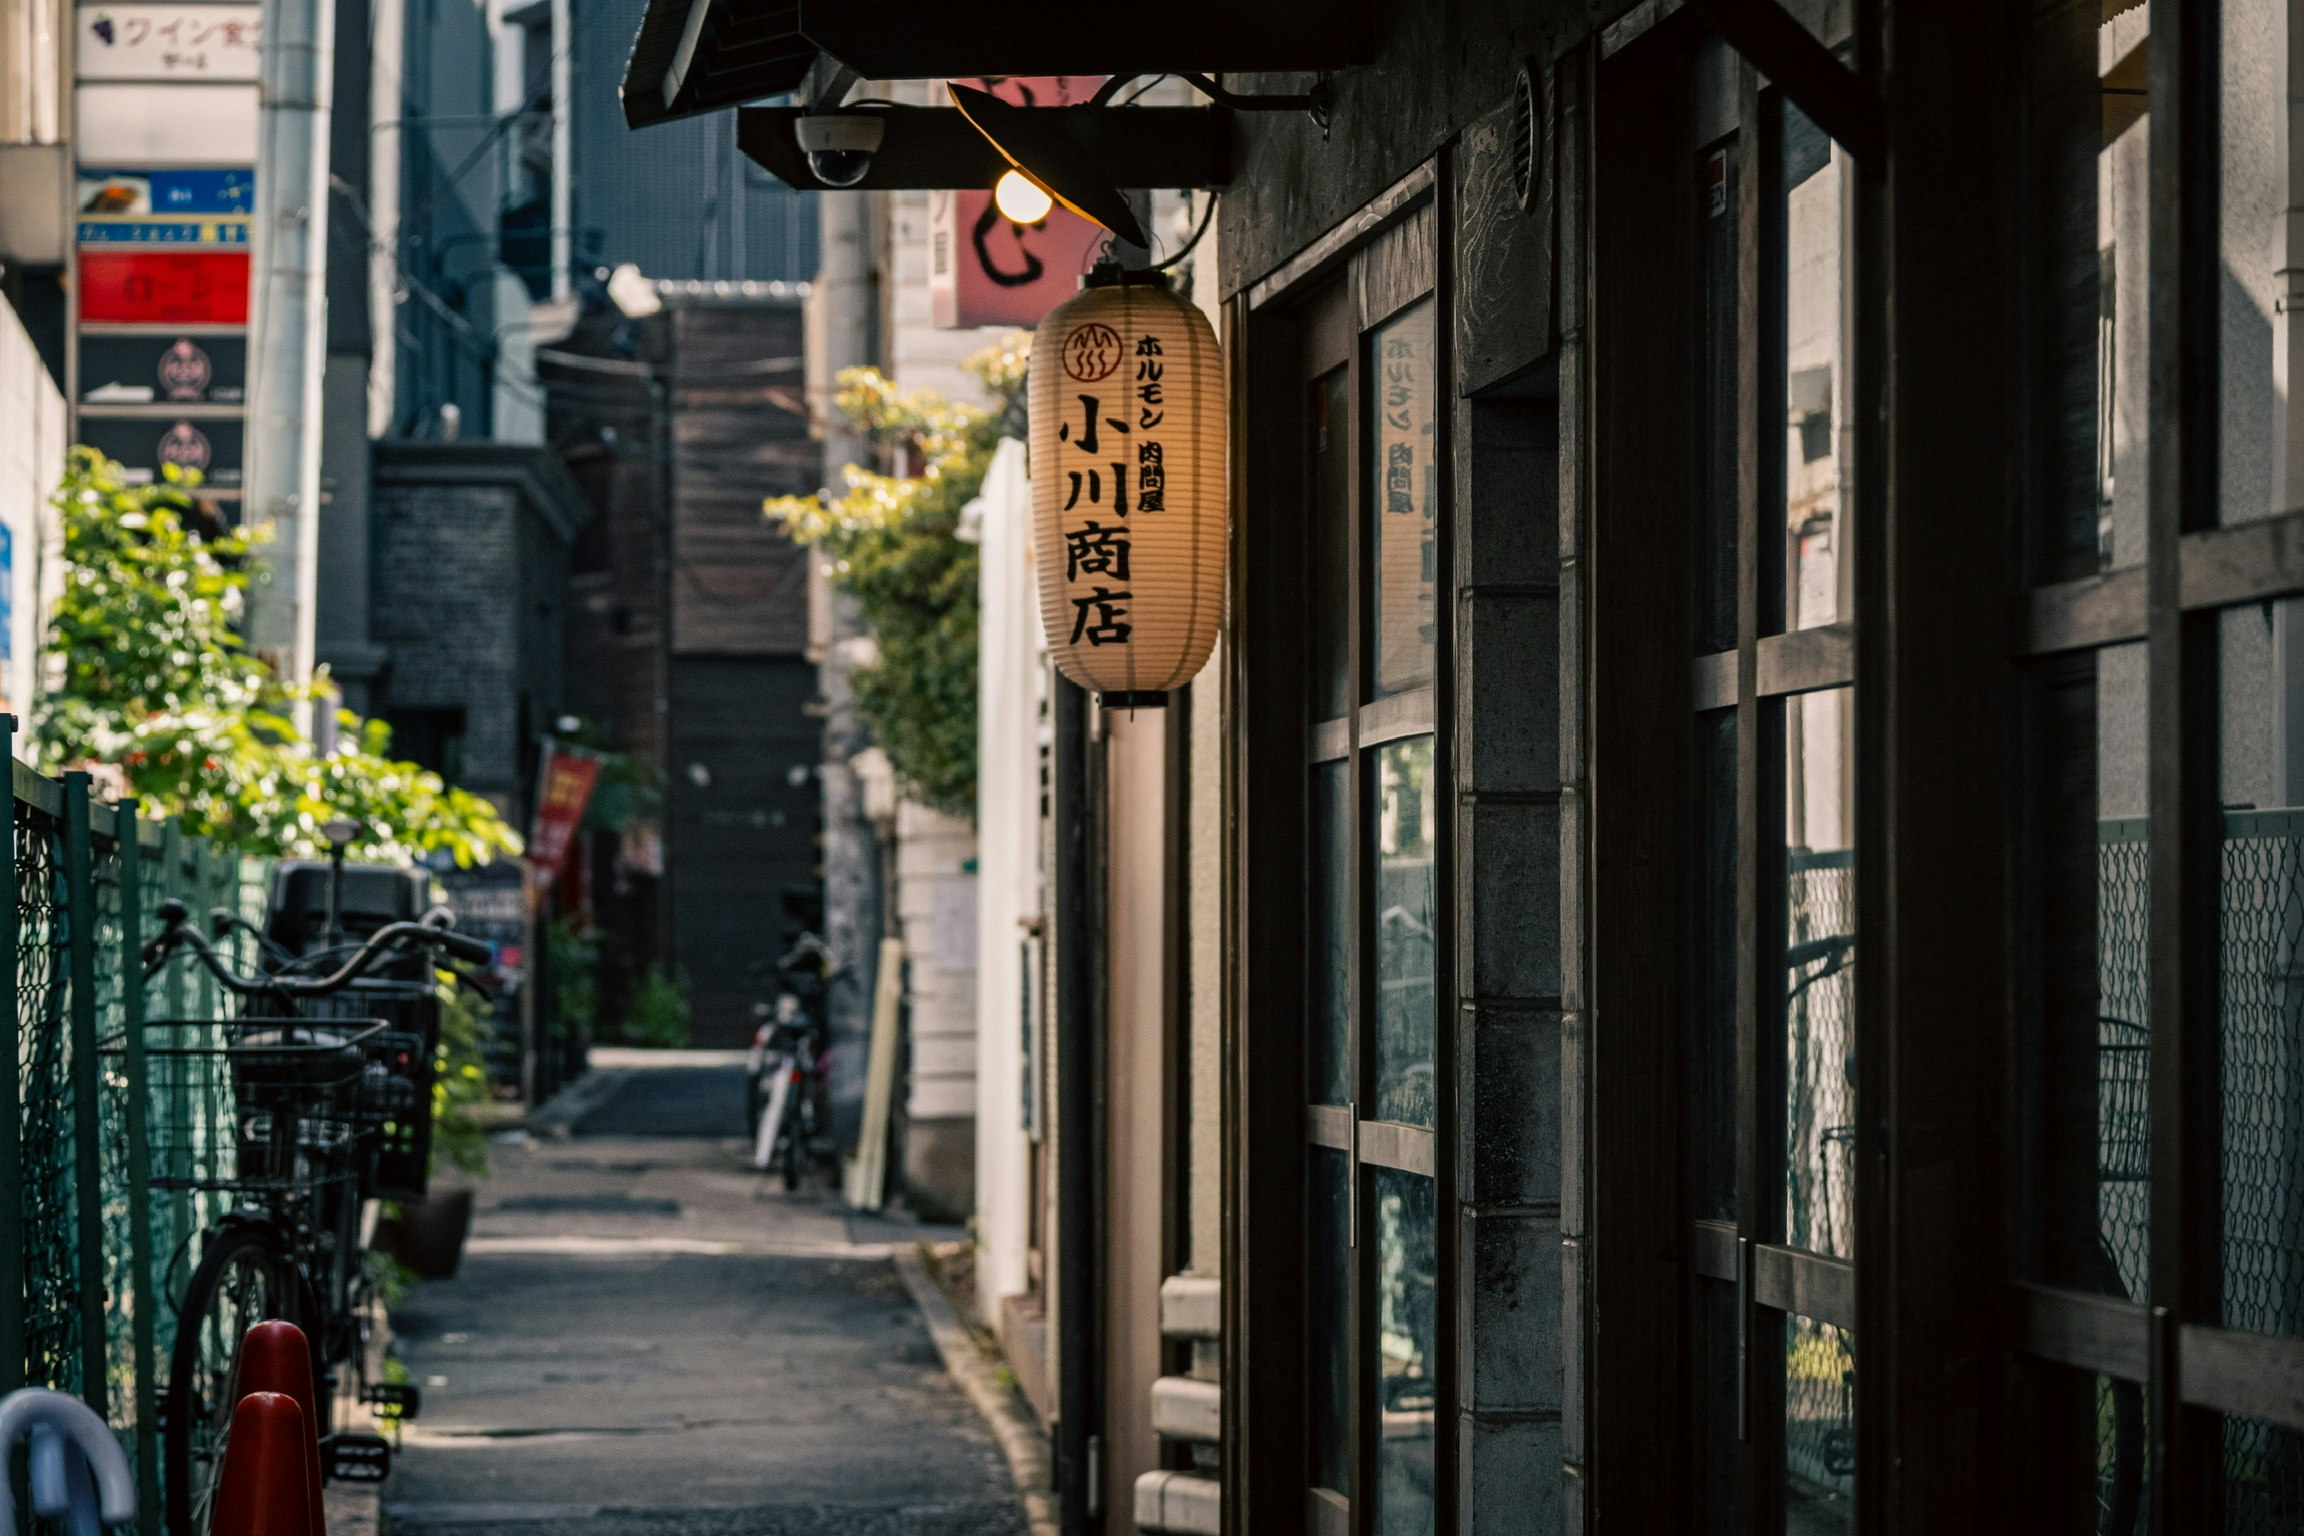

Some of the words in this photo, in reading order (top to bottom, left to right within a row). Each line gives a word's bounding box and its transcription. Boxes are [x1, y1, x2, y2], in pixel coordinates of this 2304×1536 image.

[1136, 334, 1164, 430] ホルモン
[1059, 394, 1134, 647] 小川商店
[1138, 440, 1165, 512] 肉問屋
